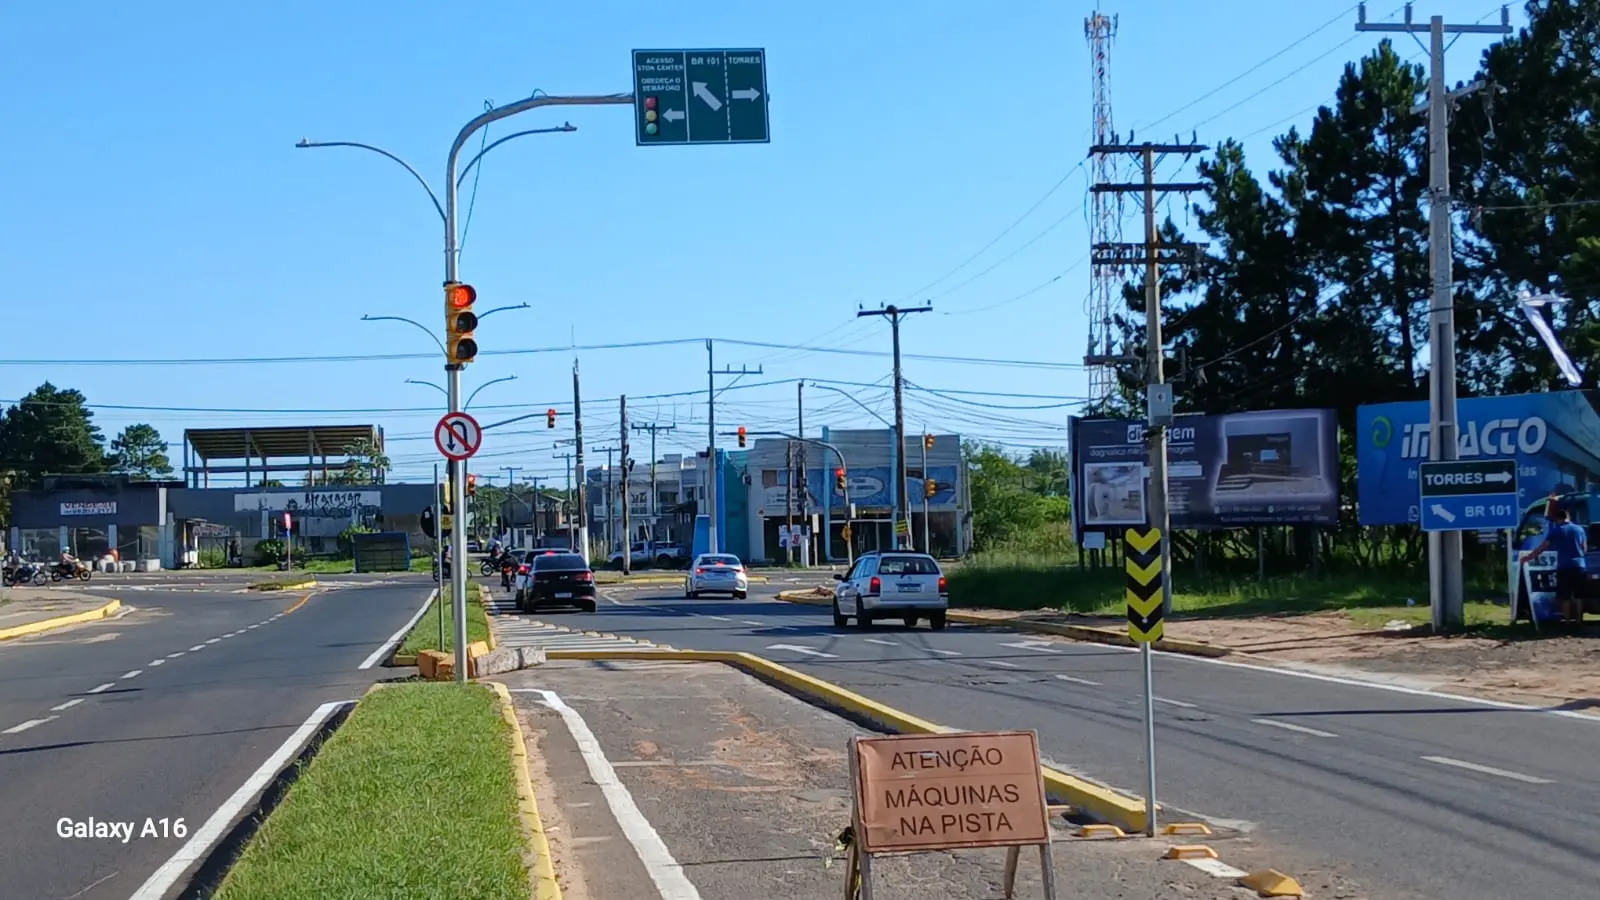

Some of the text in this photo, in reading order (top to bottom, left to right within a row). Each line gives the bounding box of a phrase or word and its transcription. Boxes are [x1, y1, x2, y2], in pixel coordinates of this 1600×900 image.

[691, 56, 720, 65] BR 101
[728, 56, 760, 64] TORRES
[1424, 473, 1483, 485] TORRES
[1465, 505, 1512, 517] BR 101
[891, 746, 1003, 772] ATENÇÃO
[885, 784, 1020, 808] MÁQUINAS
[900, 812, 1014, 836] NA PISTA
